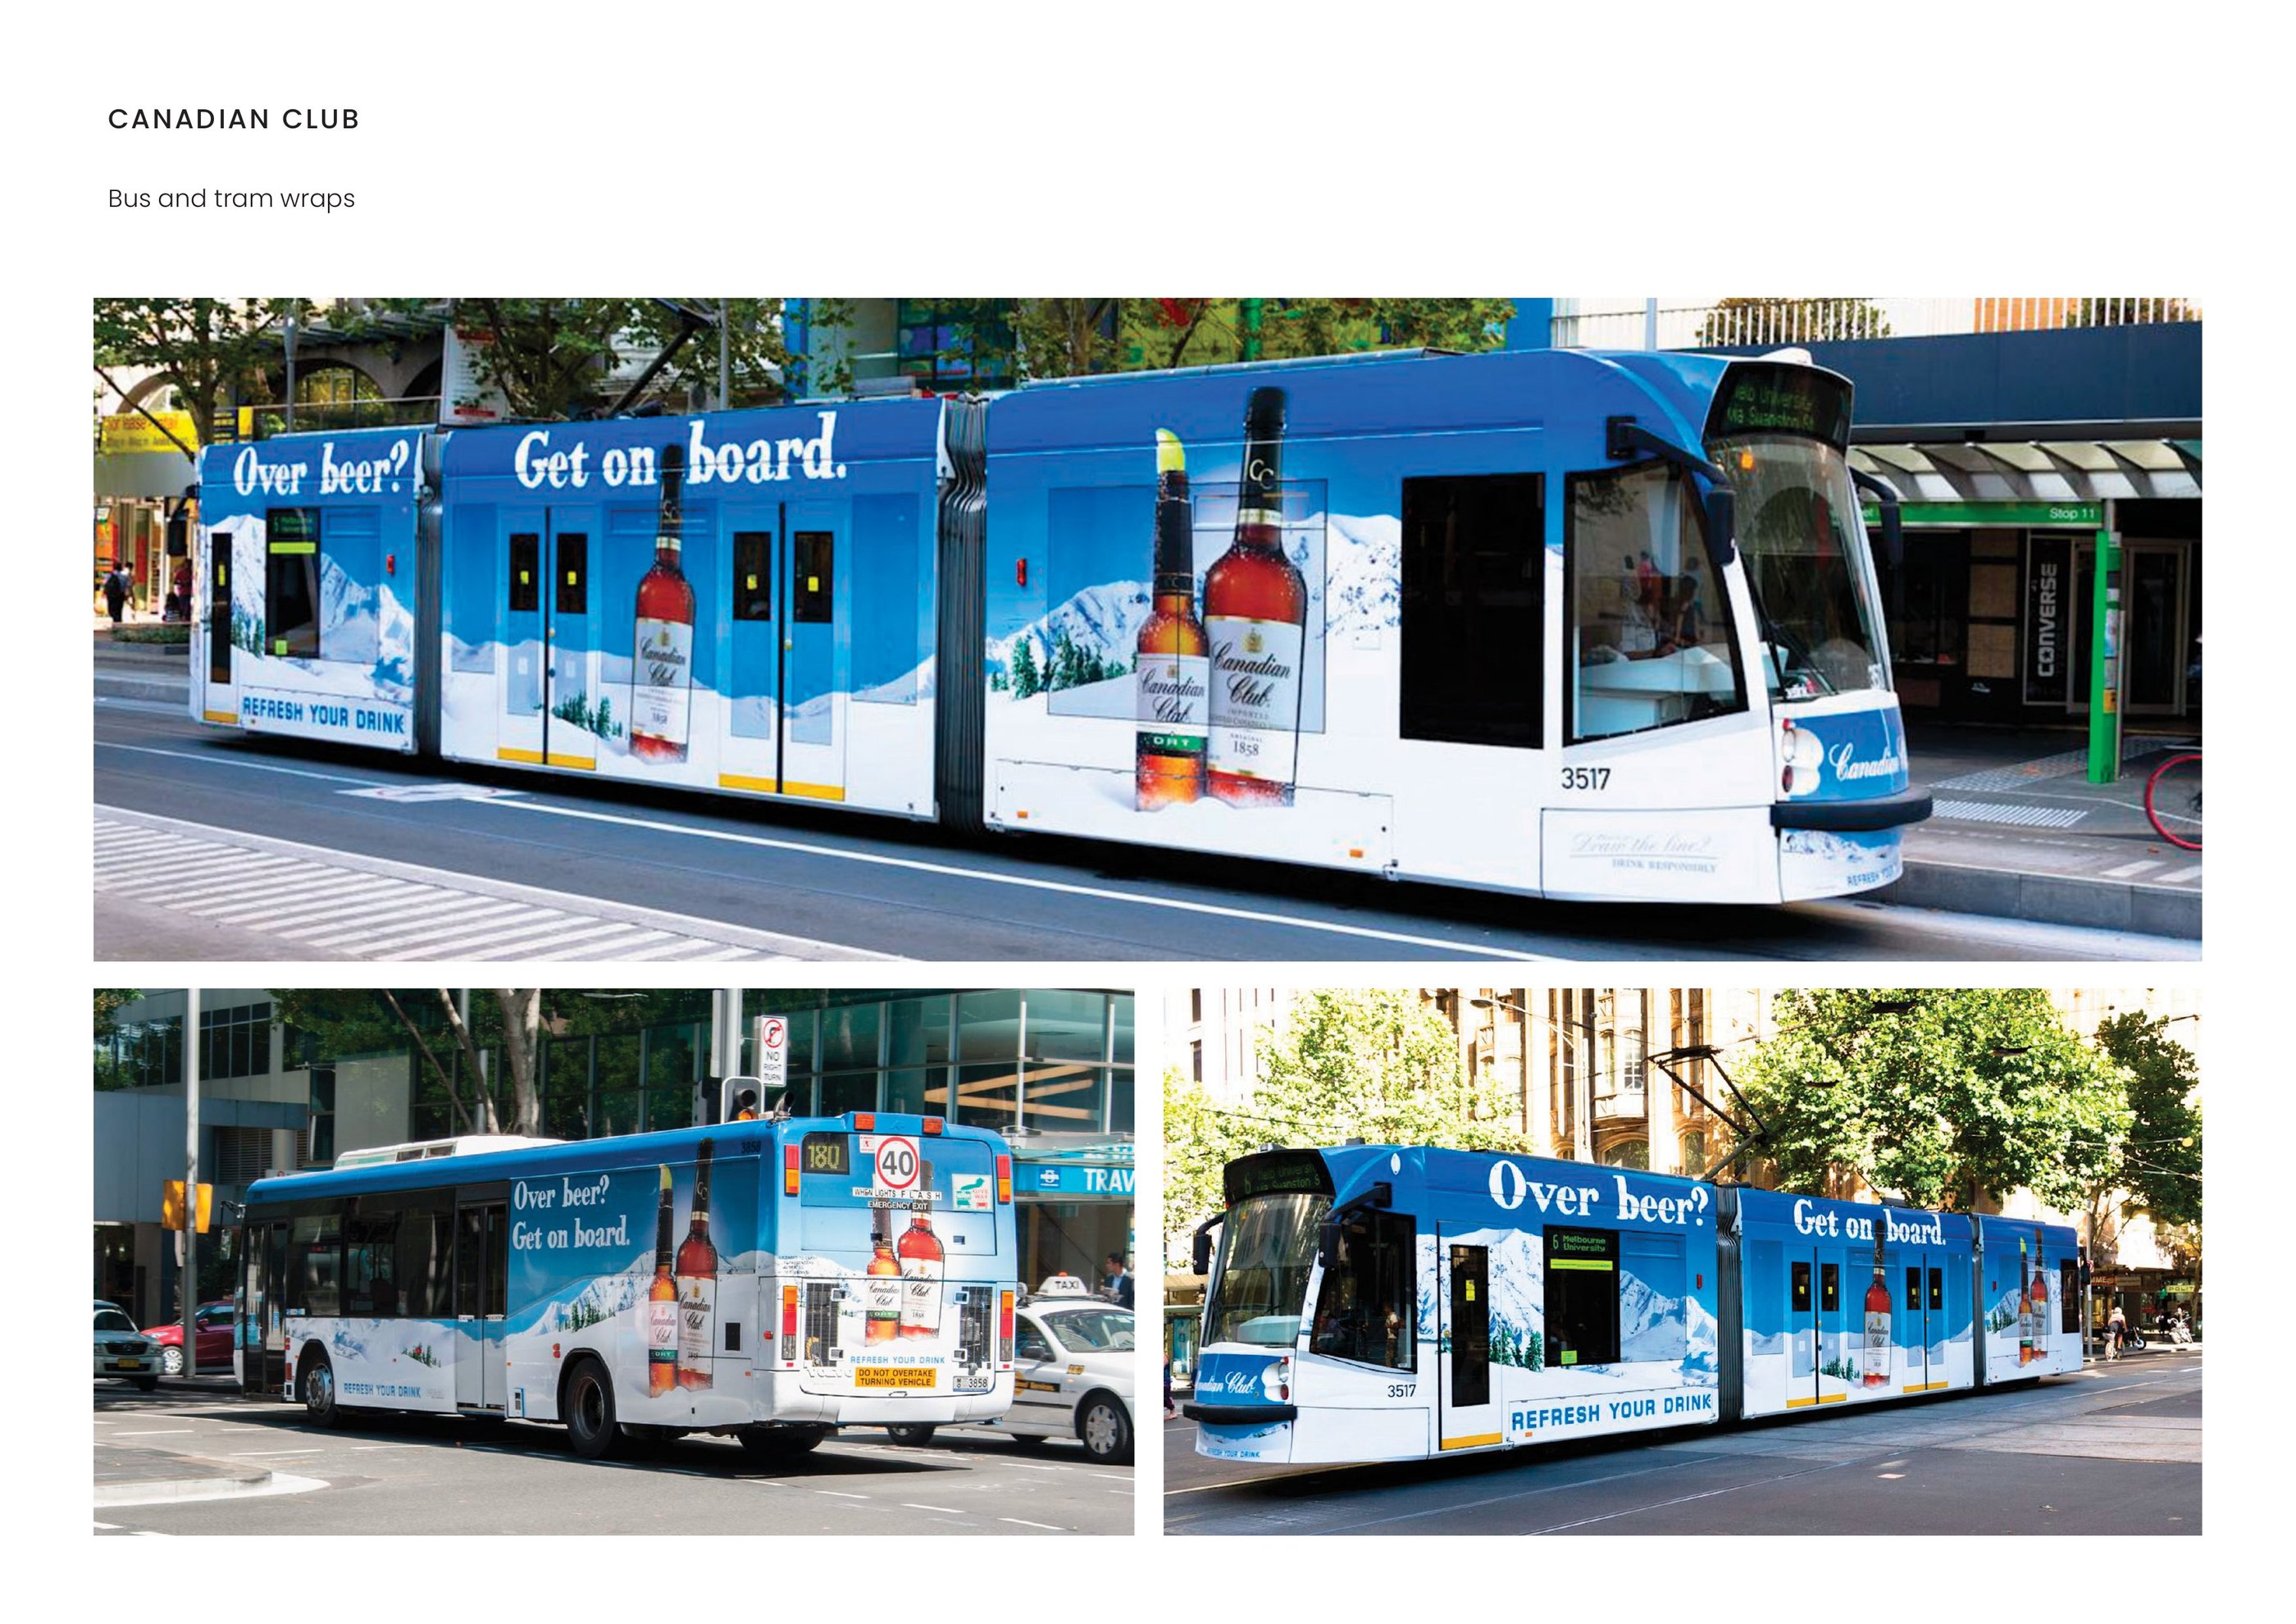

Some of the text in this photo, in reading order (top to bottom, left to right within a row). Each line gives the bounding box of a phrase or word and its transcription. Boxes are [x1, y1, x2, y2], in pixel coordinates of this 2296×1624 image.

[514, 410, 847, 490] Get on board.
[233, 439, 410, 496] Over beer?
[1248, 458, 1275, 490] CC
[2050, 507, 2095, 521] Stop 11
[2037, 563, 2058, 678] CONVERSE
[1211, 639, 1292, 680] Canadian
[1140, 666, 1205, 698] Canadian
[1226, 674, 1276, 709] Club
[242, 696, 406, 735] REFRESH YOUR DRINK
[1232, 740, 1260, 757] 1858
[1560, 767, 1611, 791] 3517
[1611, 858, 1718, 874] DRINK RESPONSIBLY
[766, 1051, 780, 1062] NO
[763, 1063, 781, 1071] RIGHT
[764, 1073, 781, 1081] TURN
[808, 1145, 840, 1170] 180
[881, 1150, 914, 1177] 40
[513, 1174, 610, 1211] Over beer?
[874, 1188, 896, 1198] LIGHTS
[1487, 1159, 1710, 1227] Over beer?
[868, 1200, 928, 1211] EMERGENCY EXIT
[1793, 1197, 1947, 1246] Get on board.
[512, 1214, 631, 1251] Get on board.
[1552, 1234, 1606, 1250] 6 Melbourne
[1563, 1243, 1606, 1252] University
[868, 1280, 900, 1294] Canadian
[909, 1283, 932, 1298] Club
[1055, 1280, 1080, 1290] TAXI
[678, 1291, 712, 1312] Canadian
[874, 1293, 895, 1307] Club
[850, 1355, 945, 1365] REFRESH YOUR DRINK
[859, 1368, 933, 1378] DO NOT OVERTAKE
[860, 1377, 932, 1386] TURNING VEHICLE
[968, 1378, 988, 1388] 3858
[1224, 1371, 1255, 1394] Club
[344, 1383, 374, 1394] REFRESH
[376, 1385, 396, 1397] YOUR
[399, 1385, 421, 1398] DRINK
[1387, 1384, 1417, 1398] 3517
[1511, 1394, 1712, 1431] REFRESH YOUR DRINK
